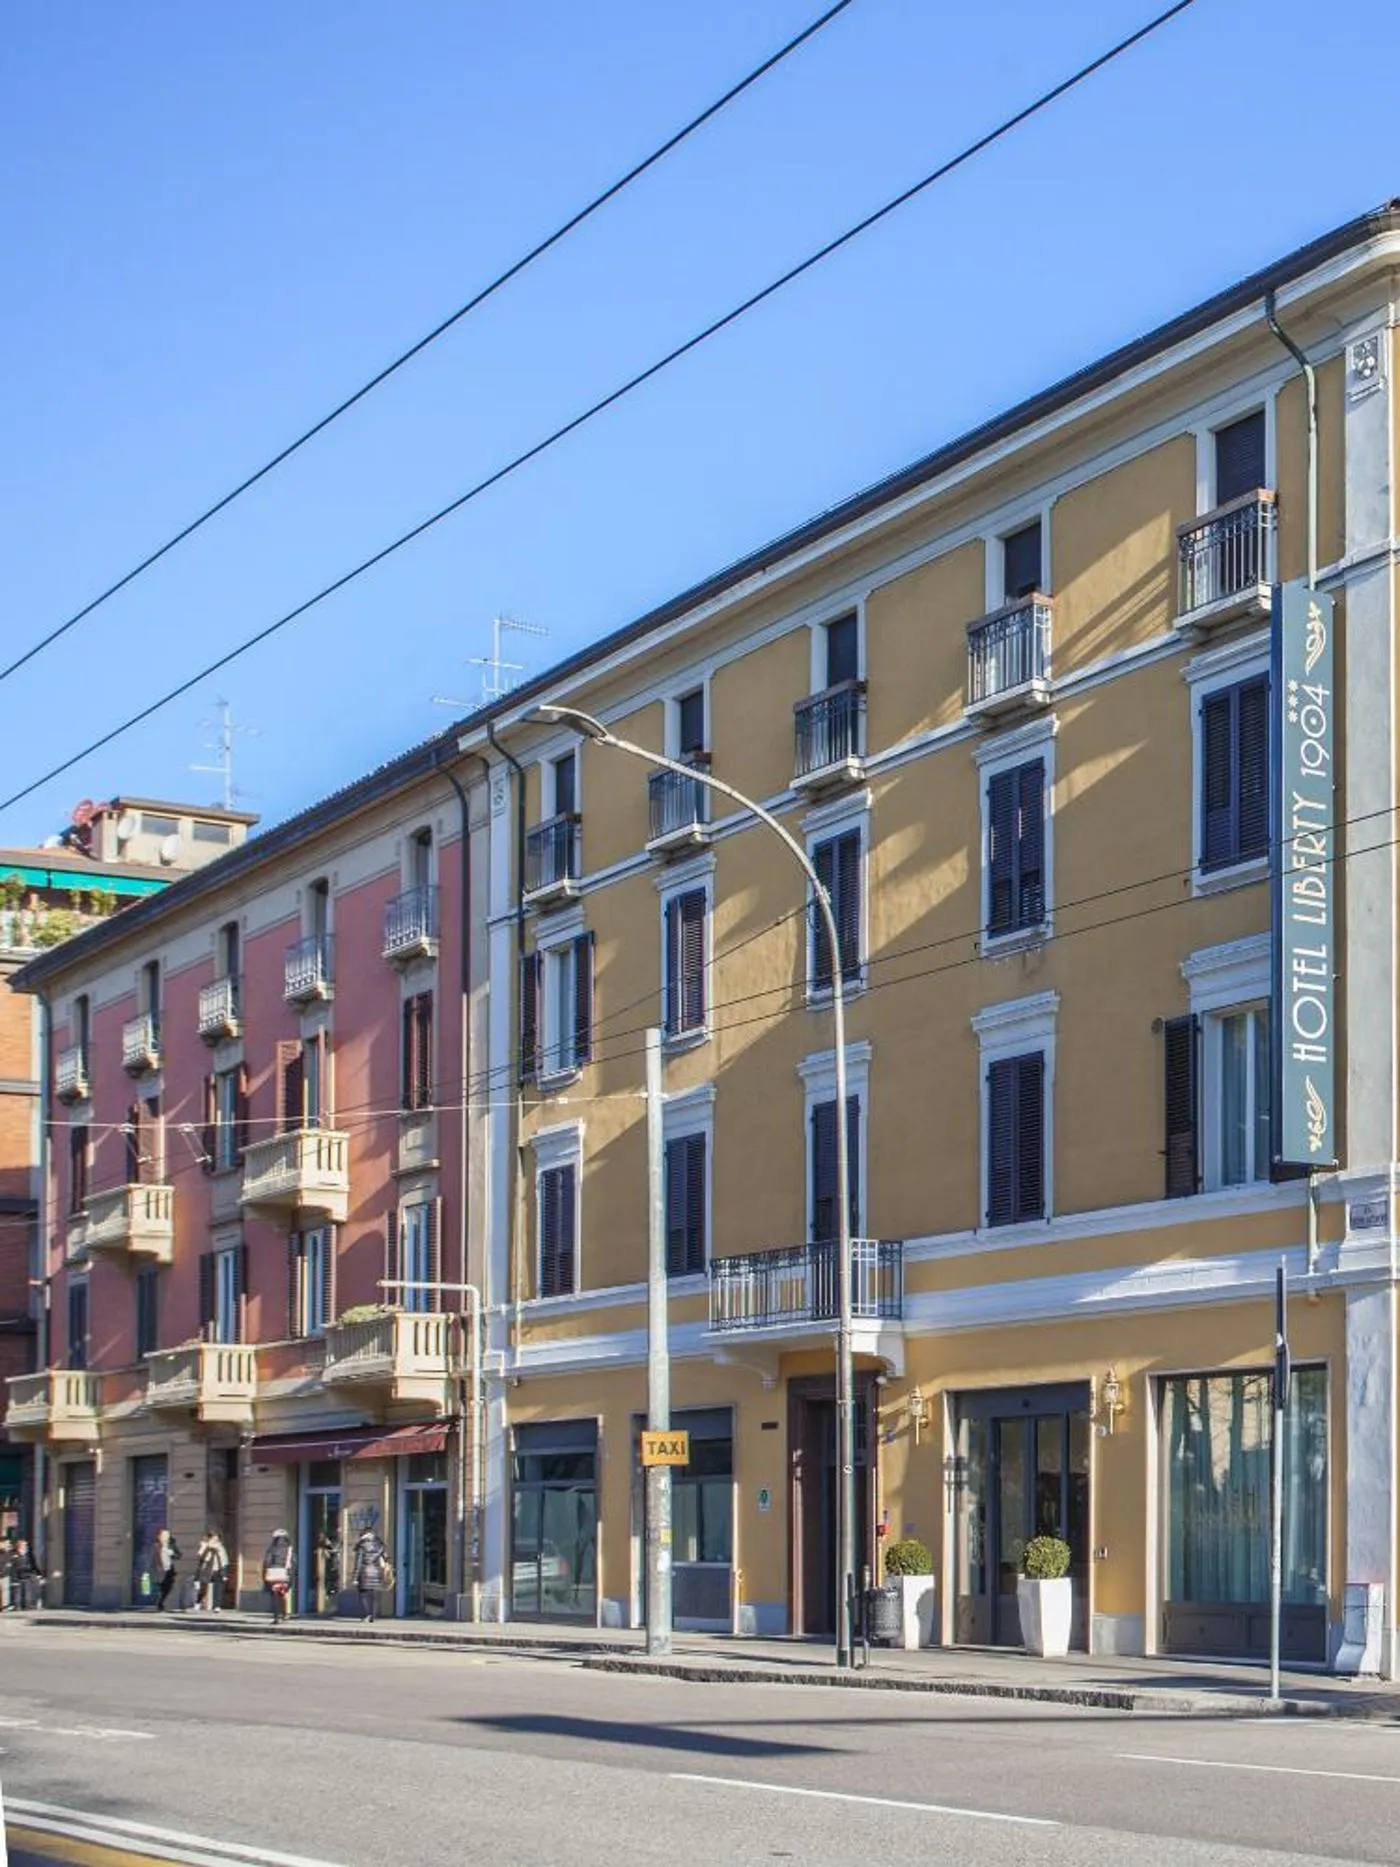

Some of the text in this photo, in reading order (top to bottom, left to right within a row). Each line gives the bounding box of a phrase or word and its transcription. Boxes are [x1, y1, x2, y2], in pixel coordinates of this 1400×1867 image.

[1292, 684, 1331, 1063] HOTEL LIBERTY 1904
[646, 1440, 686, 1456] TAXI
